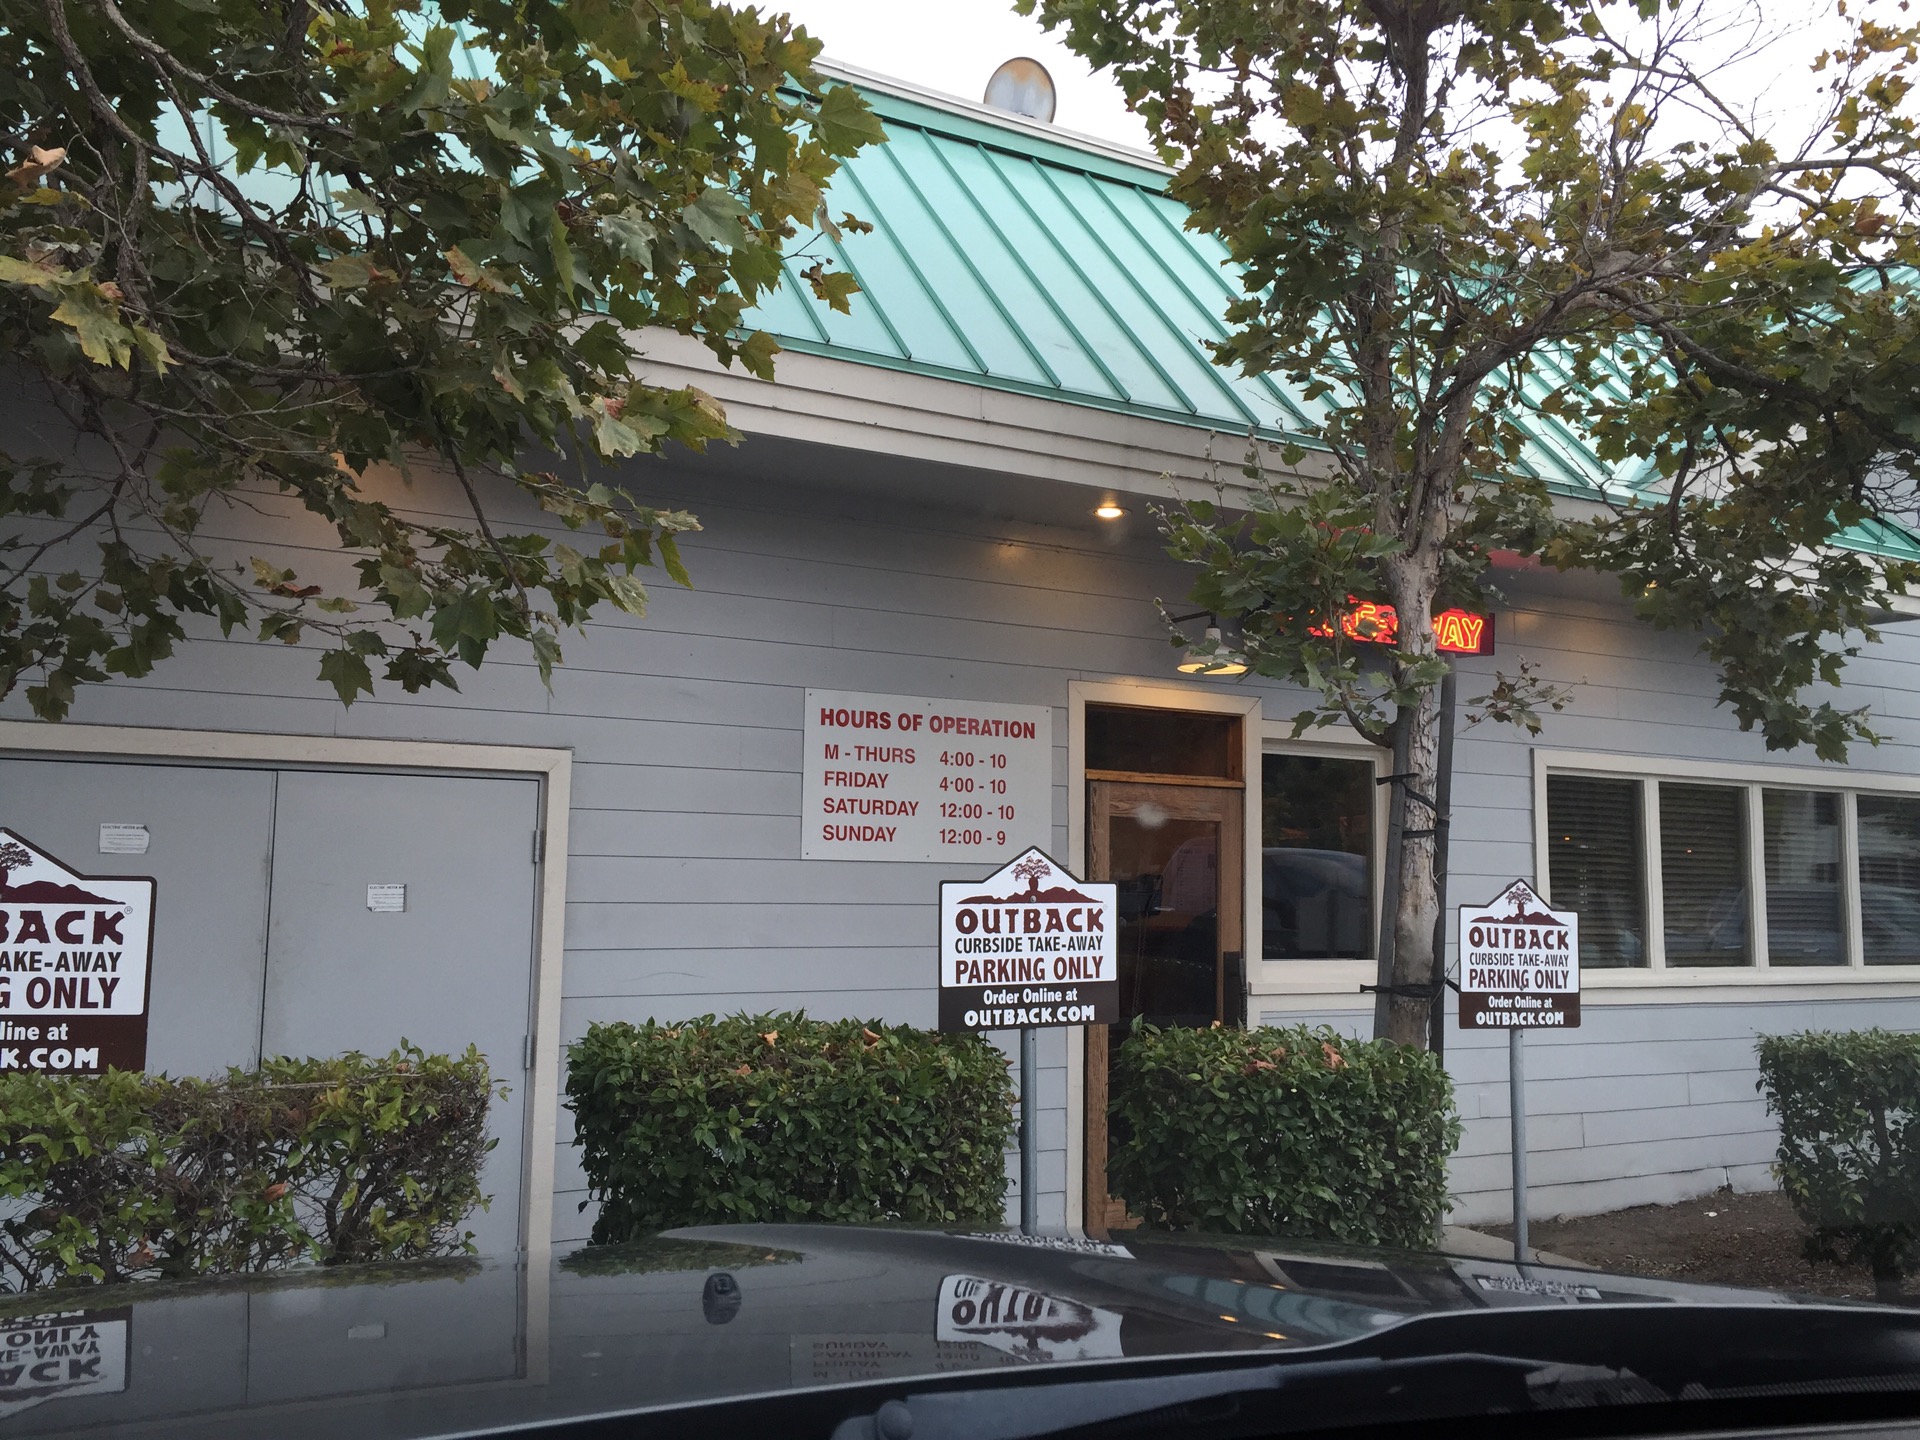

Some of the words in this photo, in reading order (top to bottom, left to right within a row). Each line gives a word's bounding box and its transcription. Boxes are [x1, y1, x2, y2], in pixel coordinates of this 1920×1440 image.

[820, 707, 891, 730] HOURS
[897, 713, 923, 732] OF
[929, 715, 1036, 740] OPERATION
[824, 744, 839, 760] M
[854, 745, 916, 764] THURS
[939, 751, 974, 768] 4:00
[990, 754, 1006, 769] 10
[824, 770, 889, 789] FRIDAY
[939, 776, 974, 793] 4:00
[990, 779, 1006, 795] 10
[823, 797, 919, 817] SATURDAY
[939, 803, 982, 819] 12:00
[998, 805, 1014, 820] 10
[822, 825, 897, 842] SUNDAY
[939, 828, 982, 845] 12:00
[996, 831, 1006, 846] 9
[0, 910, 125, 945] ACK
[955, 908, 1104, 935] OUTBACK
[955, 937, 1023, 954] CURBSIDE
[1028, 935, 1103, 952] TAKE-AWAY
[1469, 926, 1569, 951] OUTBACK
[0, 951, 122, 972] AKE-AWAY
[955, 957, 1045, 984] PARKING
[1053, 955, 1104, 981] ONLY
[1469, 952, 1514, 966] CURBSIDE
[1518, 953, 1569, 967] TAKE-AWAY
[1469, 968, 1529, 989] PARKING
[1534, 969, 1569, 989] ONLY
[26, 977, 120, 1009] ONLY
[983, 989, 1019, 1005] Order
[1023, 988, 1062, 1004] Online
[1065, 987, 1078, 1002] at
[1488, 995, 1512, 1009] Order
[1514, 996, 1542, 1009] Online
[1544, 997, 1552, 1008] at
[964, 1005, 1095, 1027] OUTBACK.COM
[1475, 1011, 1564, 1026] OUTBACK.COM
[0, 1021, 40, 1041] line
[47, 1023, 69, 1041] at
